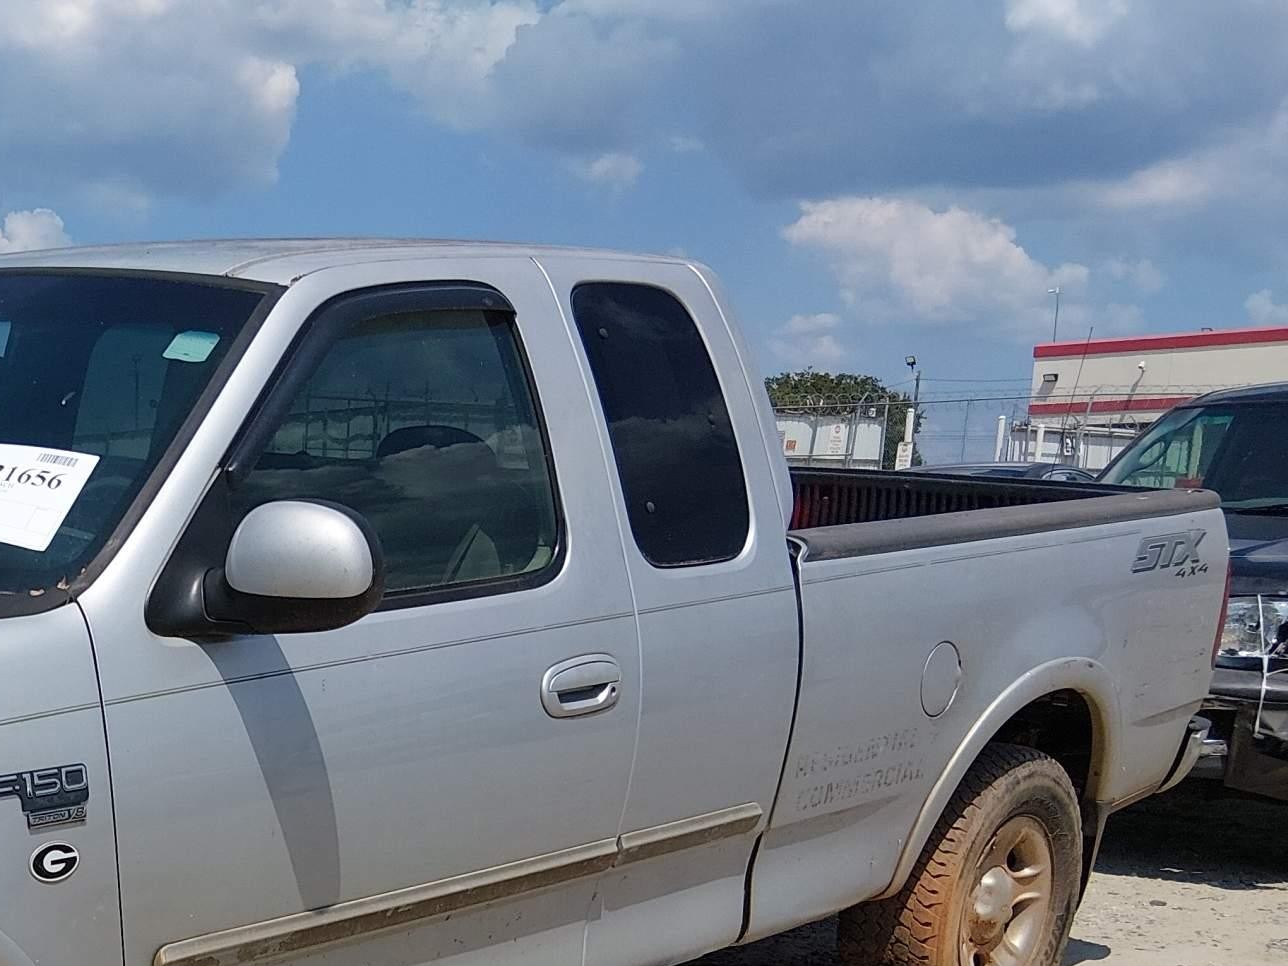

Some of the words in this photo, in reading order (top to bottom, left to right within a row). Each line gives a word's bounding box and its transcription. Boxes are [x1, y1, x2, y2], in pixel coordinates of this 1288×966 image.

[1130, 529, 1207, 574] STX
[31, 811, 66, 825] TRITON
[67, 806, 86, 820] V8
[31, 843, 78, 880] G
